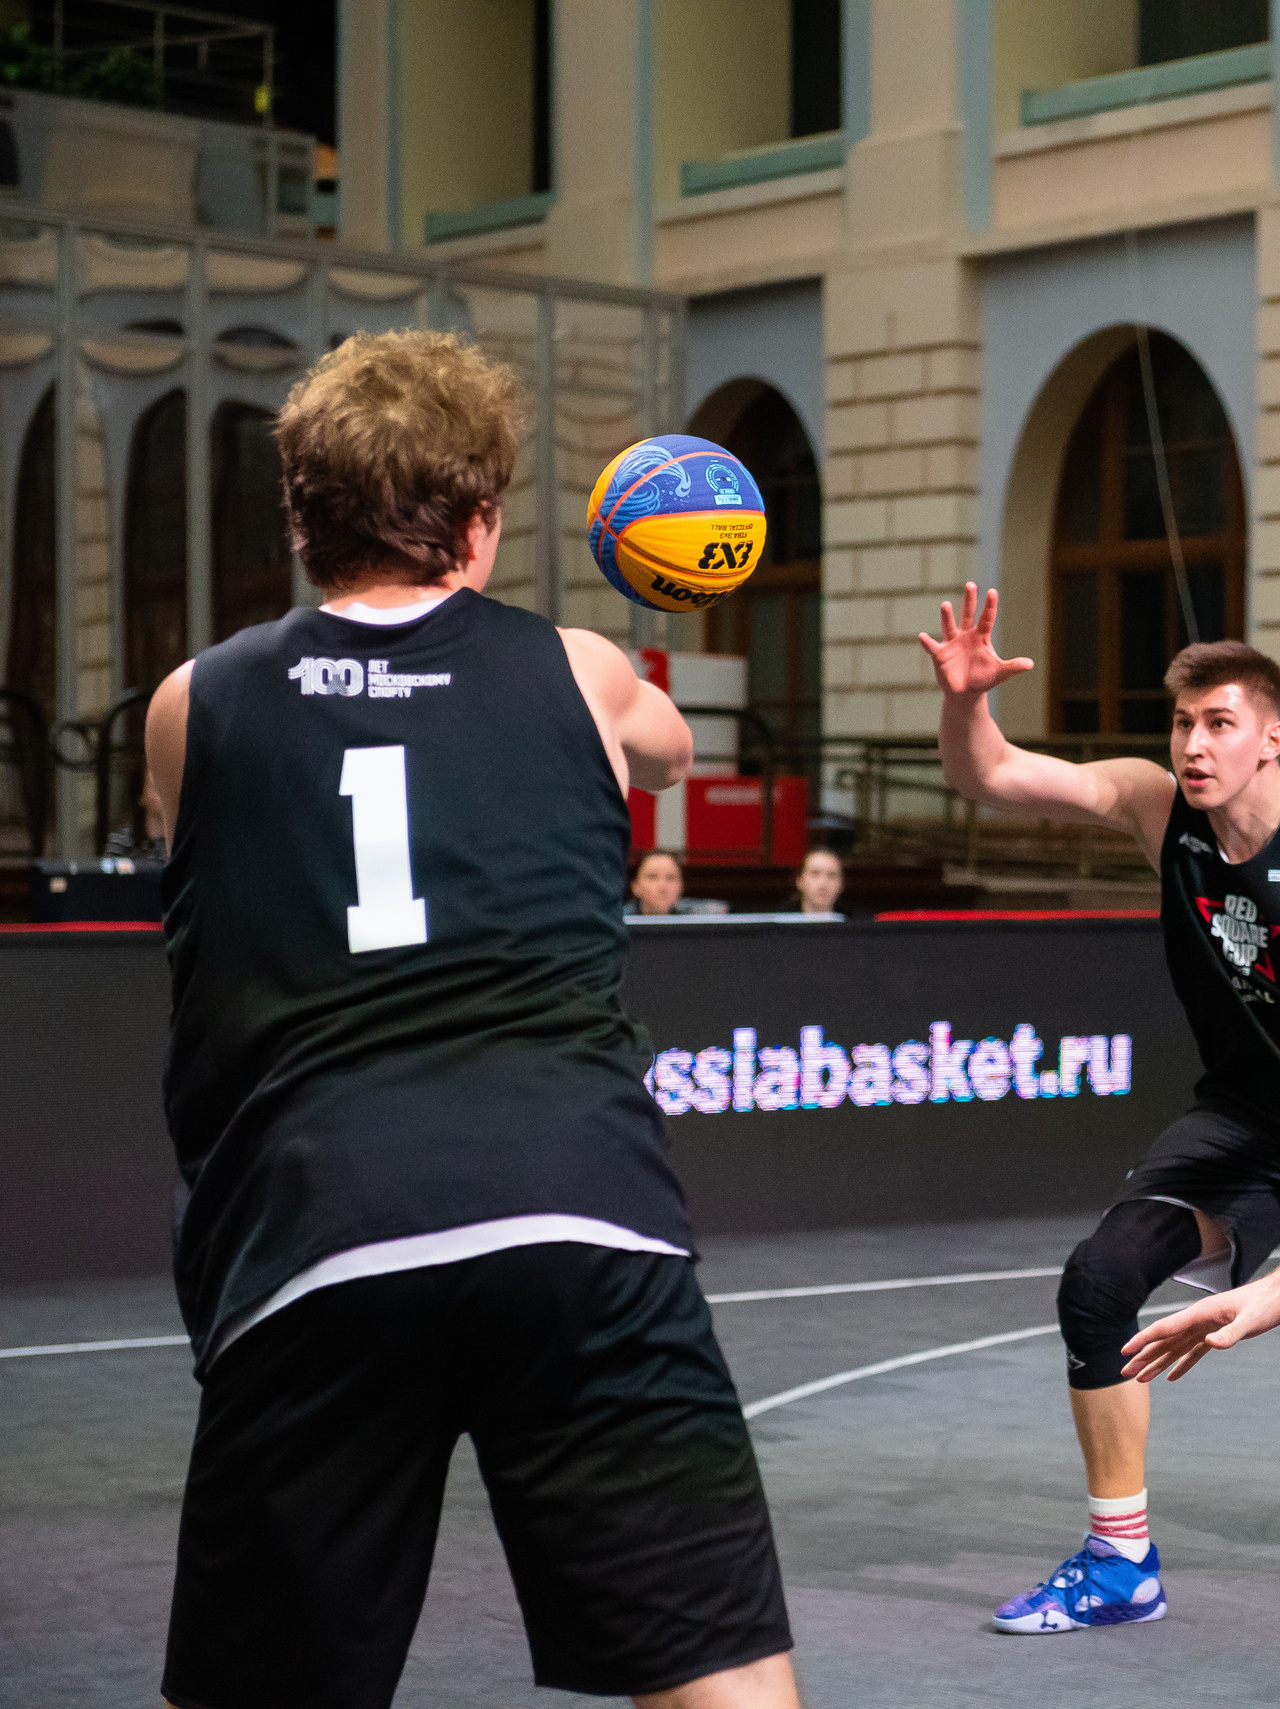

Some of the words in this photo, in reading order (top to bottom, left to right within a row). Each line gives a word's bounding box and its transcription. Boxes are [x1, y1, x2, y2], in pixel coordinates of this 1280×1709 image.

[711, 523, 728, 531] BALL
[287, 656, 364, 697] 100
[338, 745, 427, 954] 1
[1225, 894, 1258, 923] RED
[1211, 913, 1269, 948] SQUARE
[1222, 938, 1259, 967] CUP
[643, 1020, 1132, 1116] ssiabasket.ru
